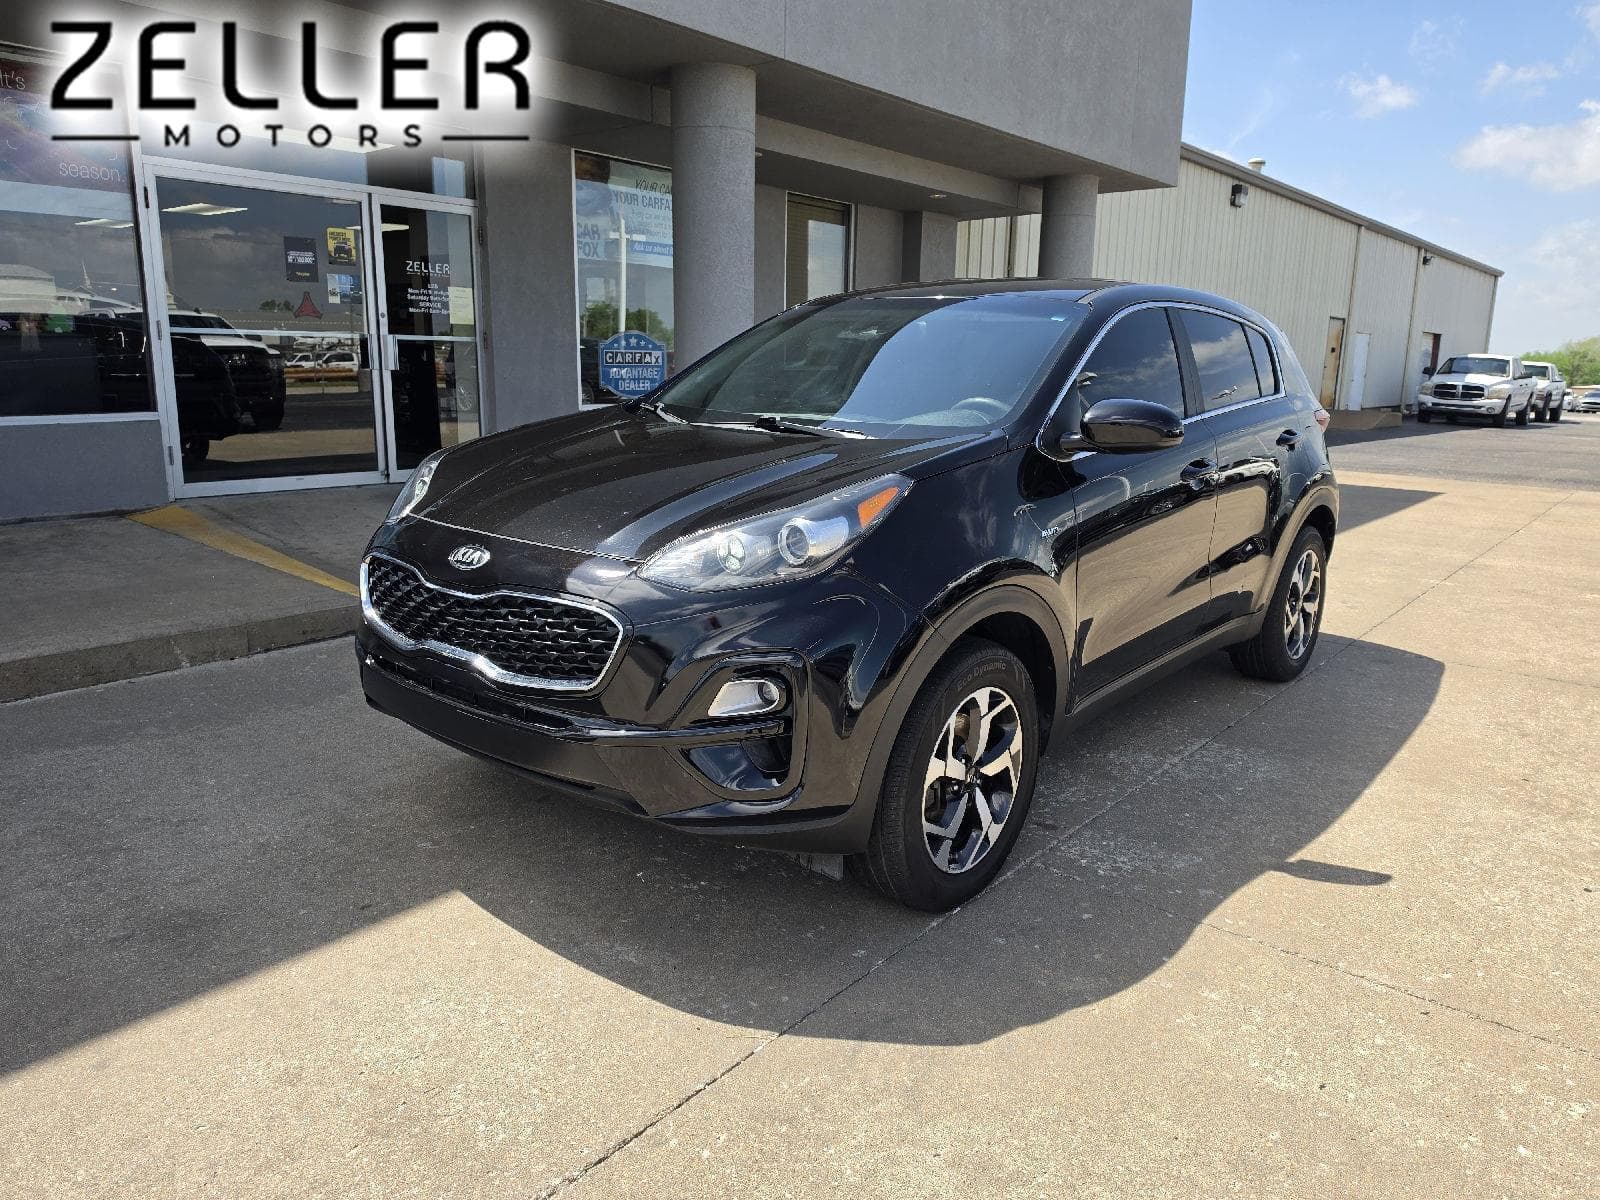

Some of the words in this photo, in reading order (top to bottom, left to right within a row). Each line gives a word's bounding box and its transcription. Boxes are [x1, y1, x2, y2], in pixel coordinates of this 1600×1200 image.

[59, 161, 127, 182] season.
[641, 194, 672, 211] CARFA
[405, 260, 450, 275] ZELLER
[605, 351, 661, 365] CARFAX
[609, 367, 660, 379] ADVANTAGE
[618, 379, 651, 391] DEALER
[452, 547, 487, 566] KIA
